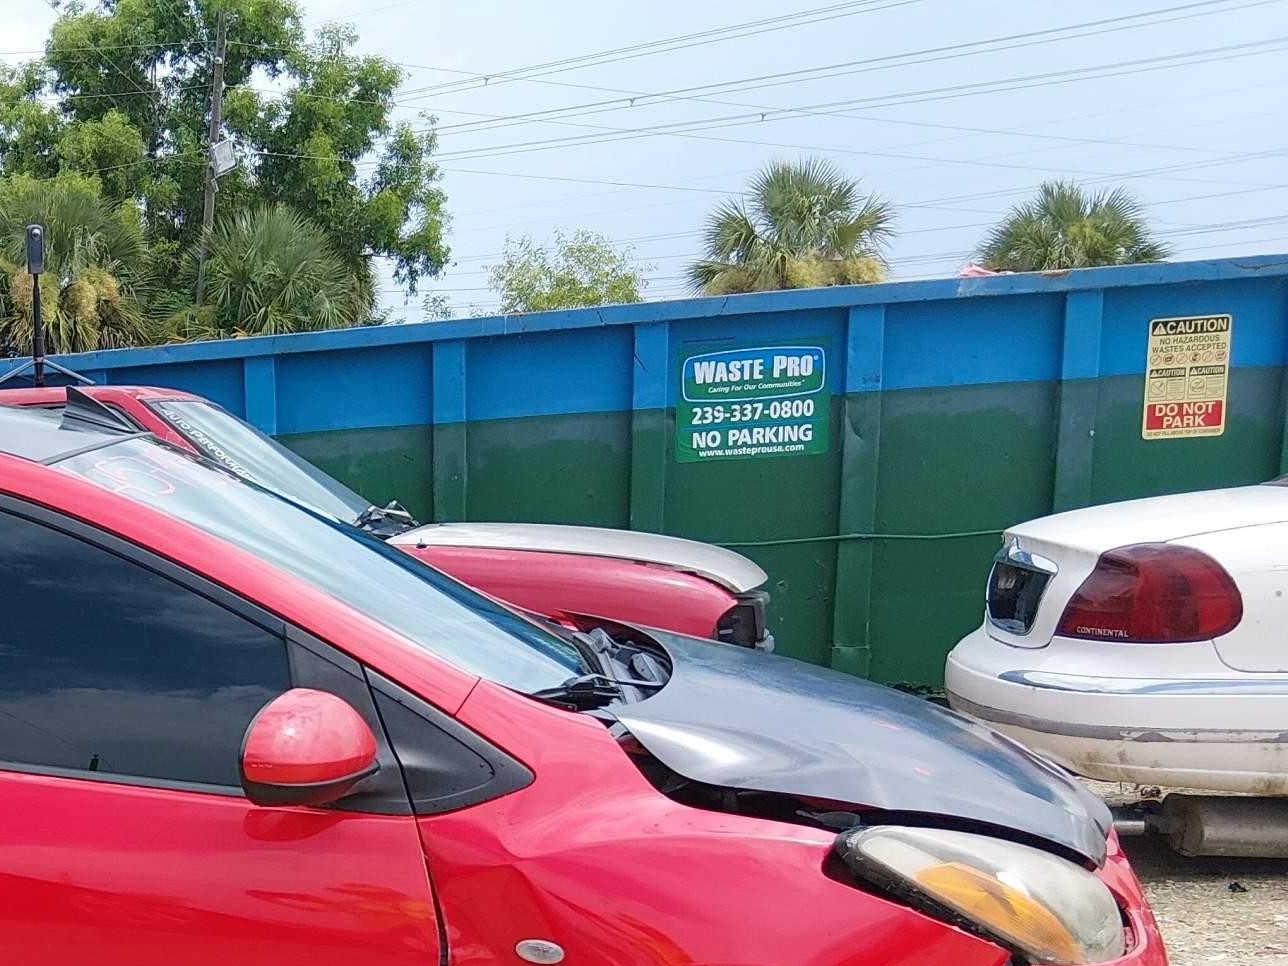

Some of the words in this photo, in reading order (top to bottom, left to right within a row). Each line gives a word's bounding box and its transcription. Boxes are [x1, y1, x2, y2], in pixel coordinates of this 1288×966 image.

[1166, 318, 1227, 334] CAUTION
[1159, 337, 1172, 345] NO
[1172, 334, 1220, 344] HAZARDOUS
[1152, 345, 1185, 353] WASTES
[1185, 343, 1227, 352] ACCEPTED
[694, 359, 764, 384] WASTE
[1158, 369, 1185, 377] CAUTION
[1197, 366, 1224, 375] CAUTION
[708, 386, 730, 394] Caring
[691, 399, 814, 425] 239-337-0800
[1155, 403, 1178, 417] DO
[1182, 401, 1216, 415] NOT
[1163, 414, 1206, 429] PARK
[692, 430, 721, 448] NO
[727, 424, 813, 446] PARKING
[699, 444, 804, 457] www.wasteprousa.com
[1076, 625, 1129, 638] CONTINENTAL
